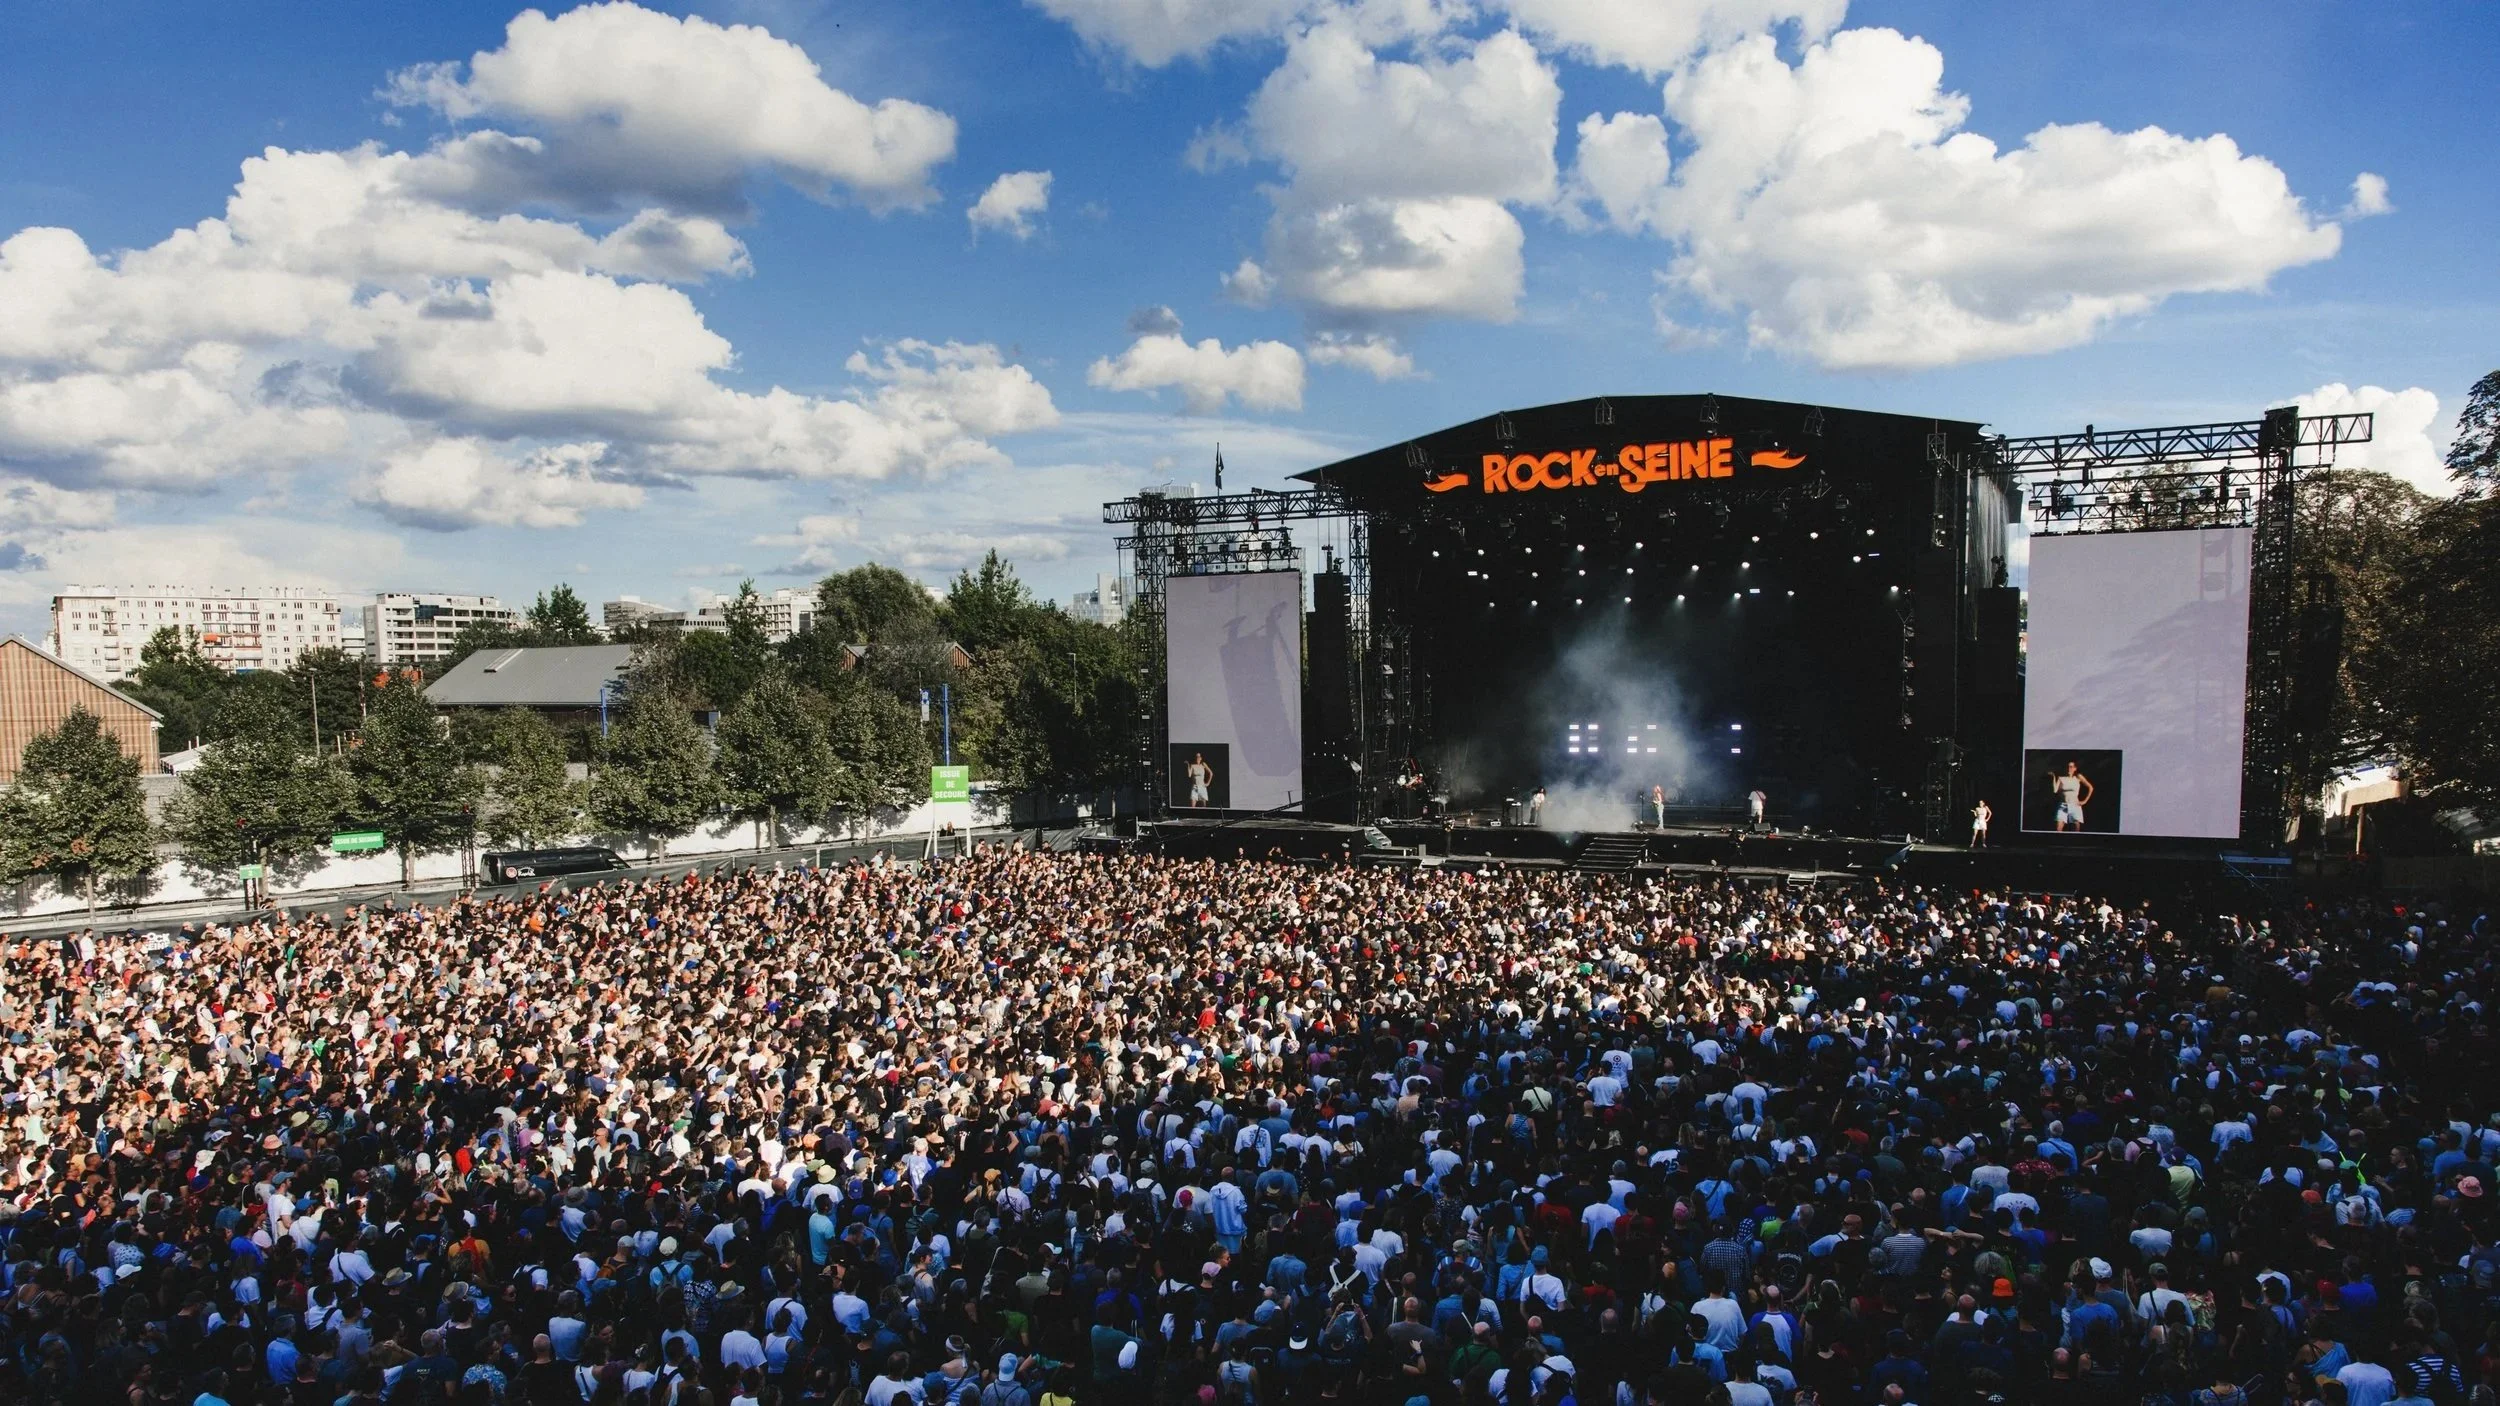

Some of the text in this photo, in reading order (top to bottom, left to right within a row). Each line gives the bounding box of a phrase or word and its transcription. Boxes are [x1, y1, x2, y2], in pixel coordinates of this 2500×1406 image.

[1482, 438, 1734, 494] ROCK en SEINE
[940, 770, 960, 778] ISSUE
[945, 780, 956, 788] DE
[934, 790, 967, 798] SECOURS
